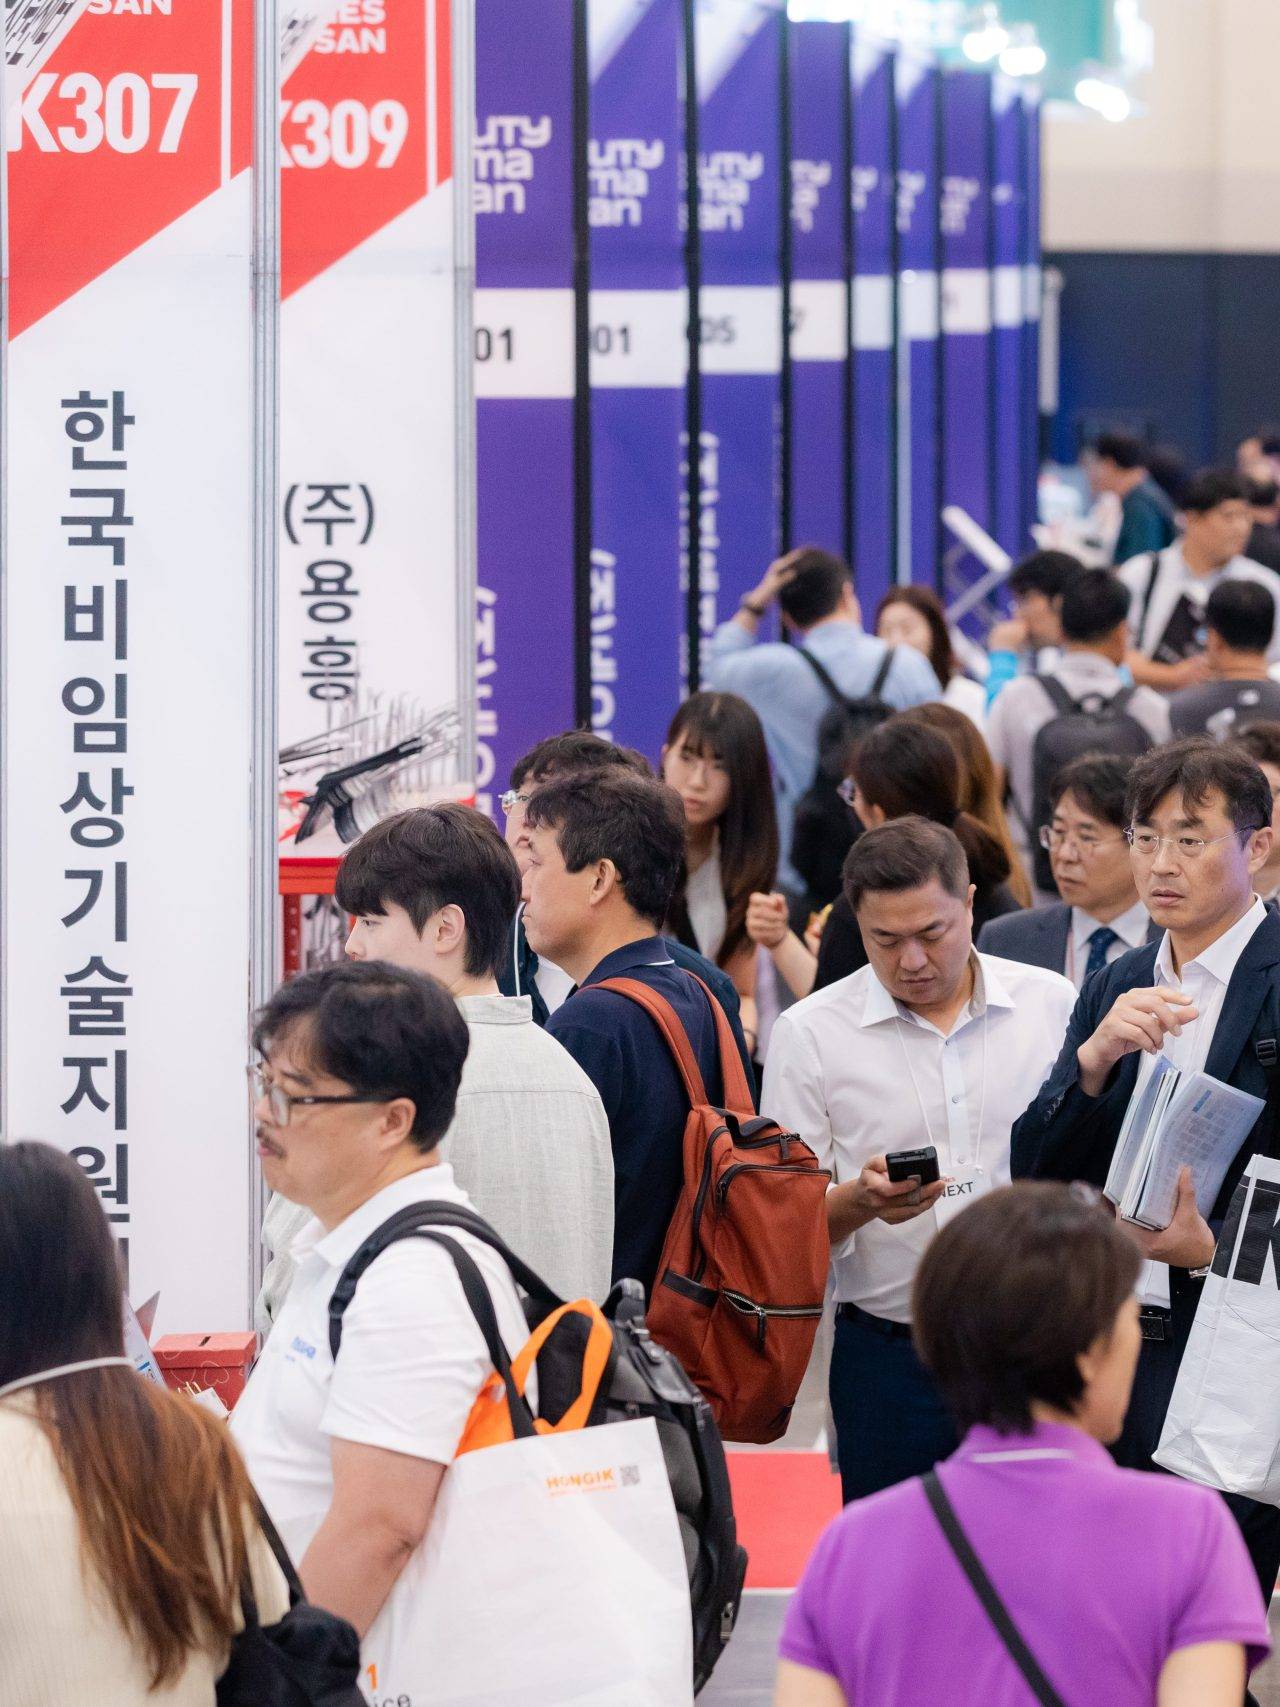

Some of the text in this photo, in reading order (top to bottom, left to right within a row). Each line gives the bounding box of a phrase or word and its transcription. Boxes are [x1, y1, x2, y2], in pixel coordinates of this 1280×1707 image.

[330, 0, 387, 24] ES
[6, 72, 198, 153] K307
[60, 390, 135, 1265] 한국비임상기술지원
